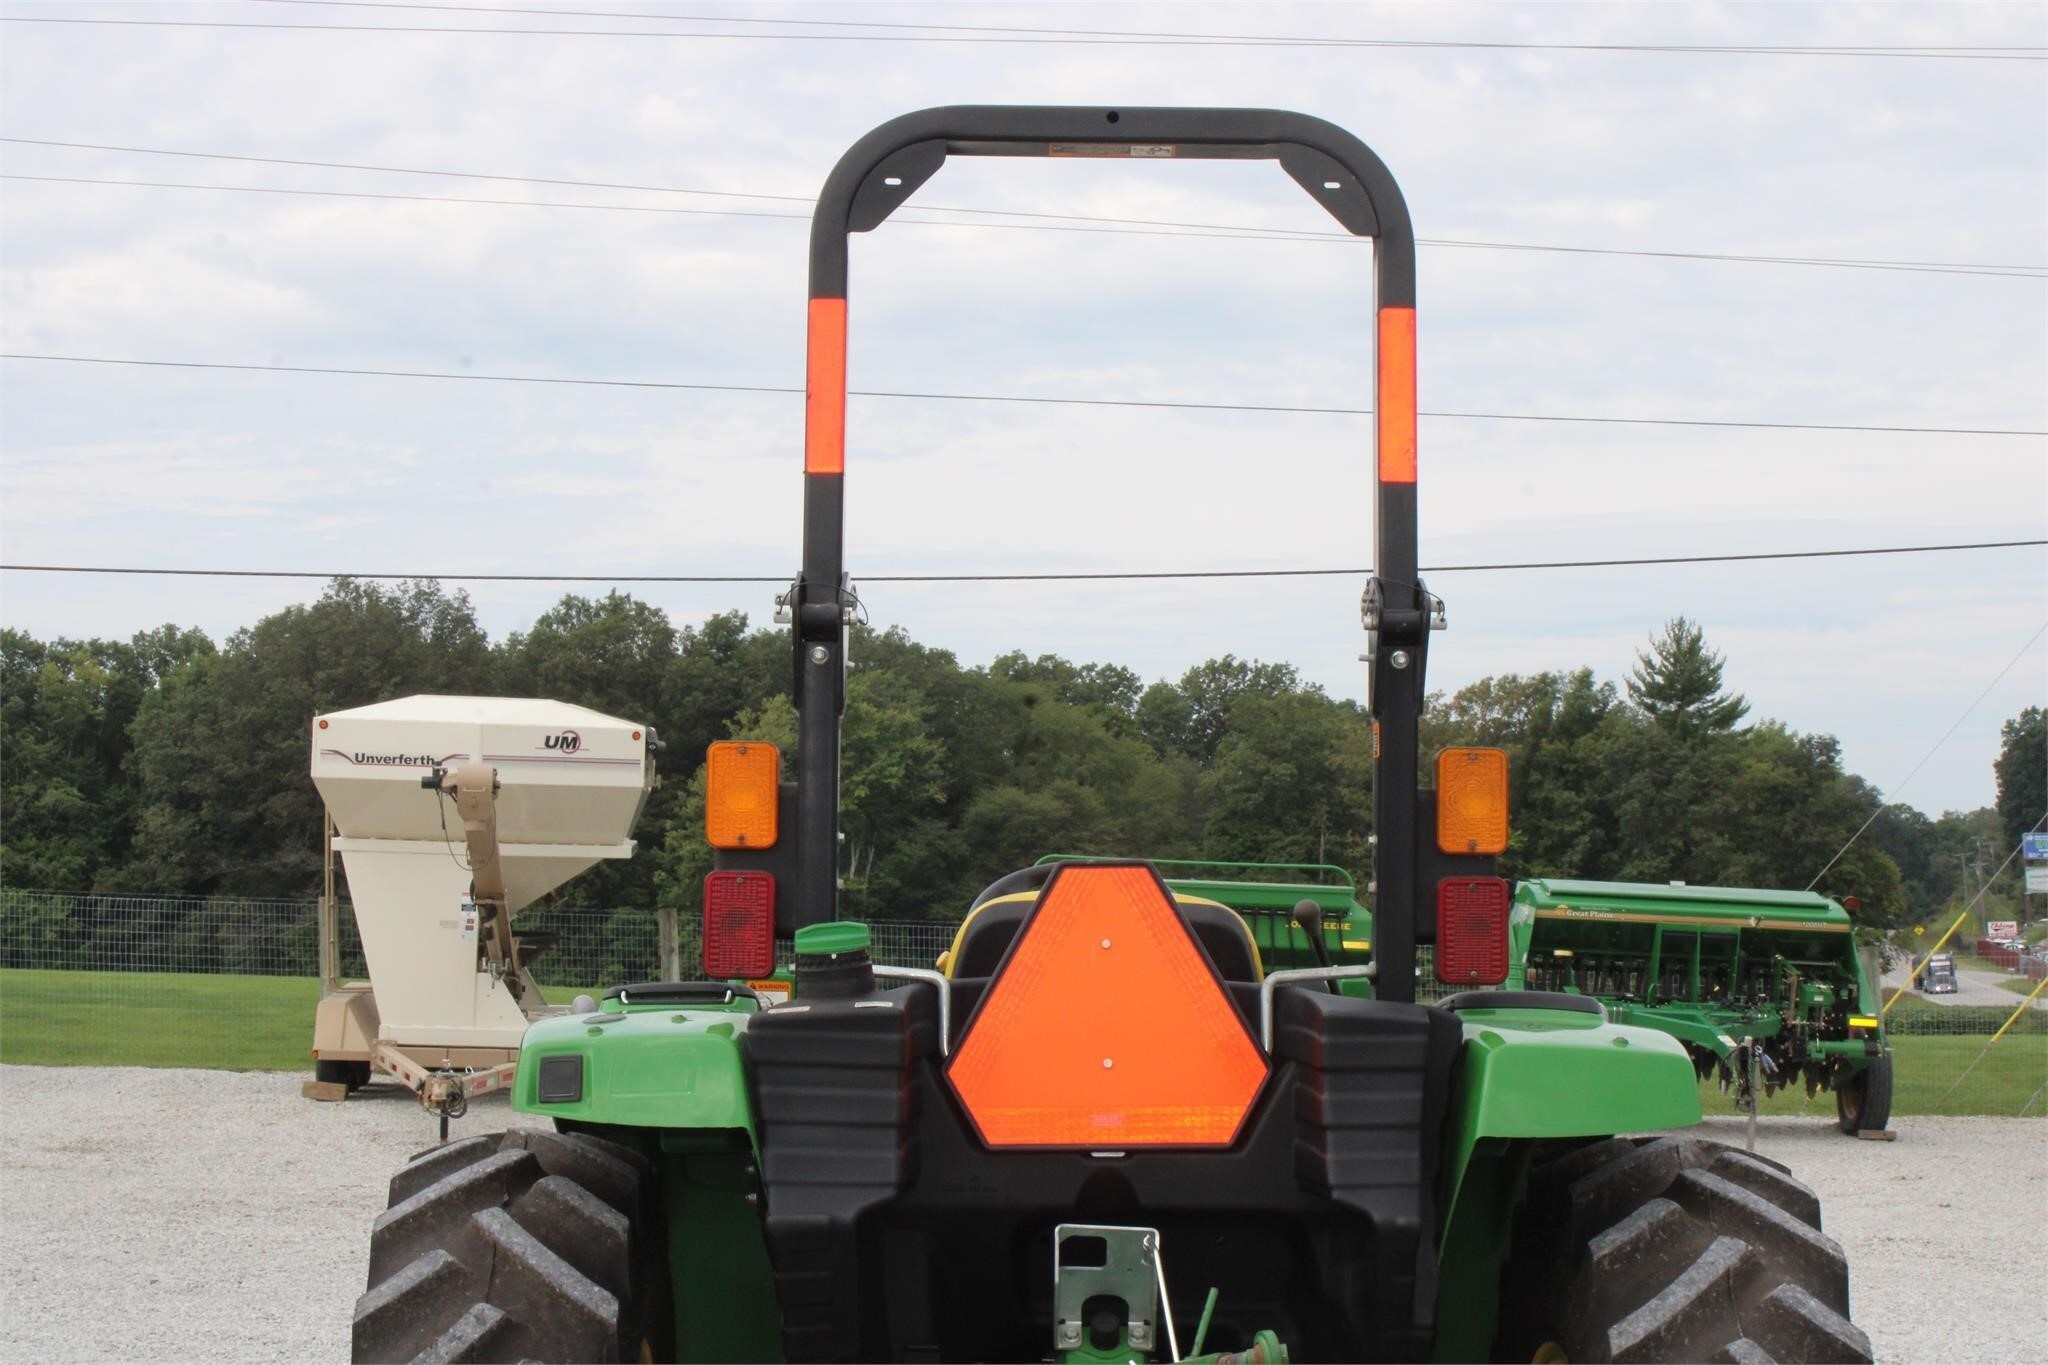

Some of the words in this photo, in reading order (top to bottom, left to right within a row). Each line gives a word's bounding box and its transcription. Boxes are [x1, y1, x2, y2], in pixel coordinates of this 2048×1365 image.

[543, 734, 579, 750] UM
[353, 751, 436, 766] Unverferth
[1320, 921, 1351, 931] EERE
